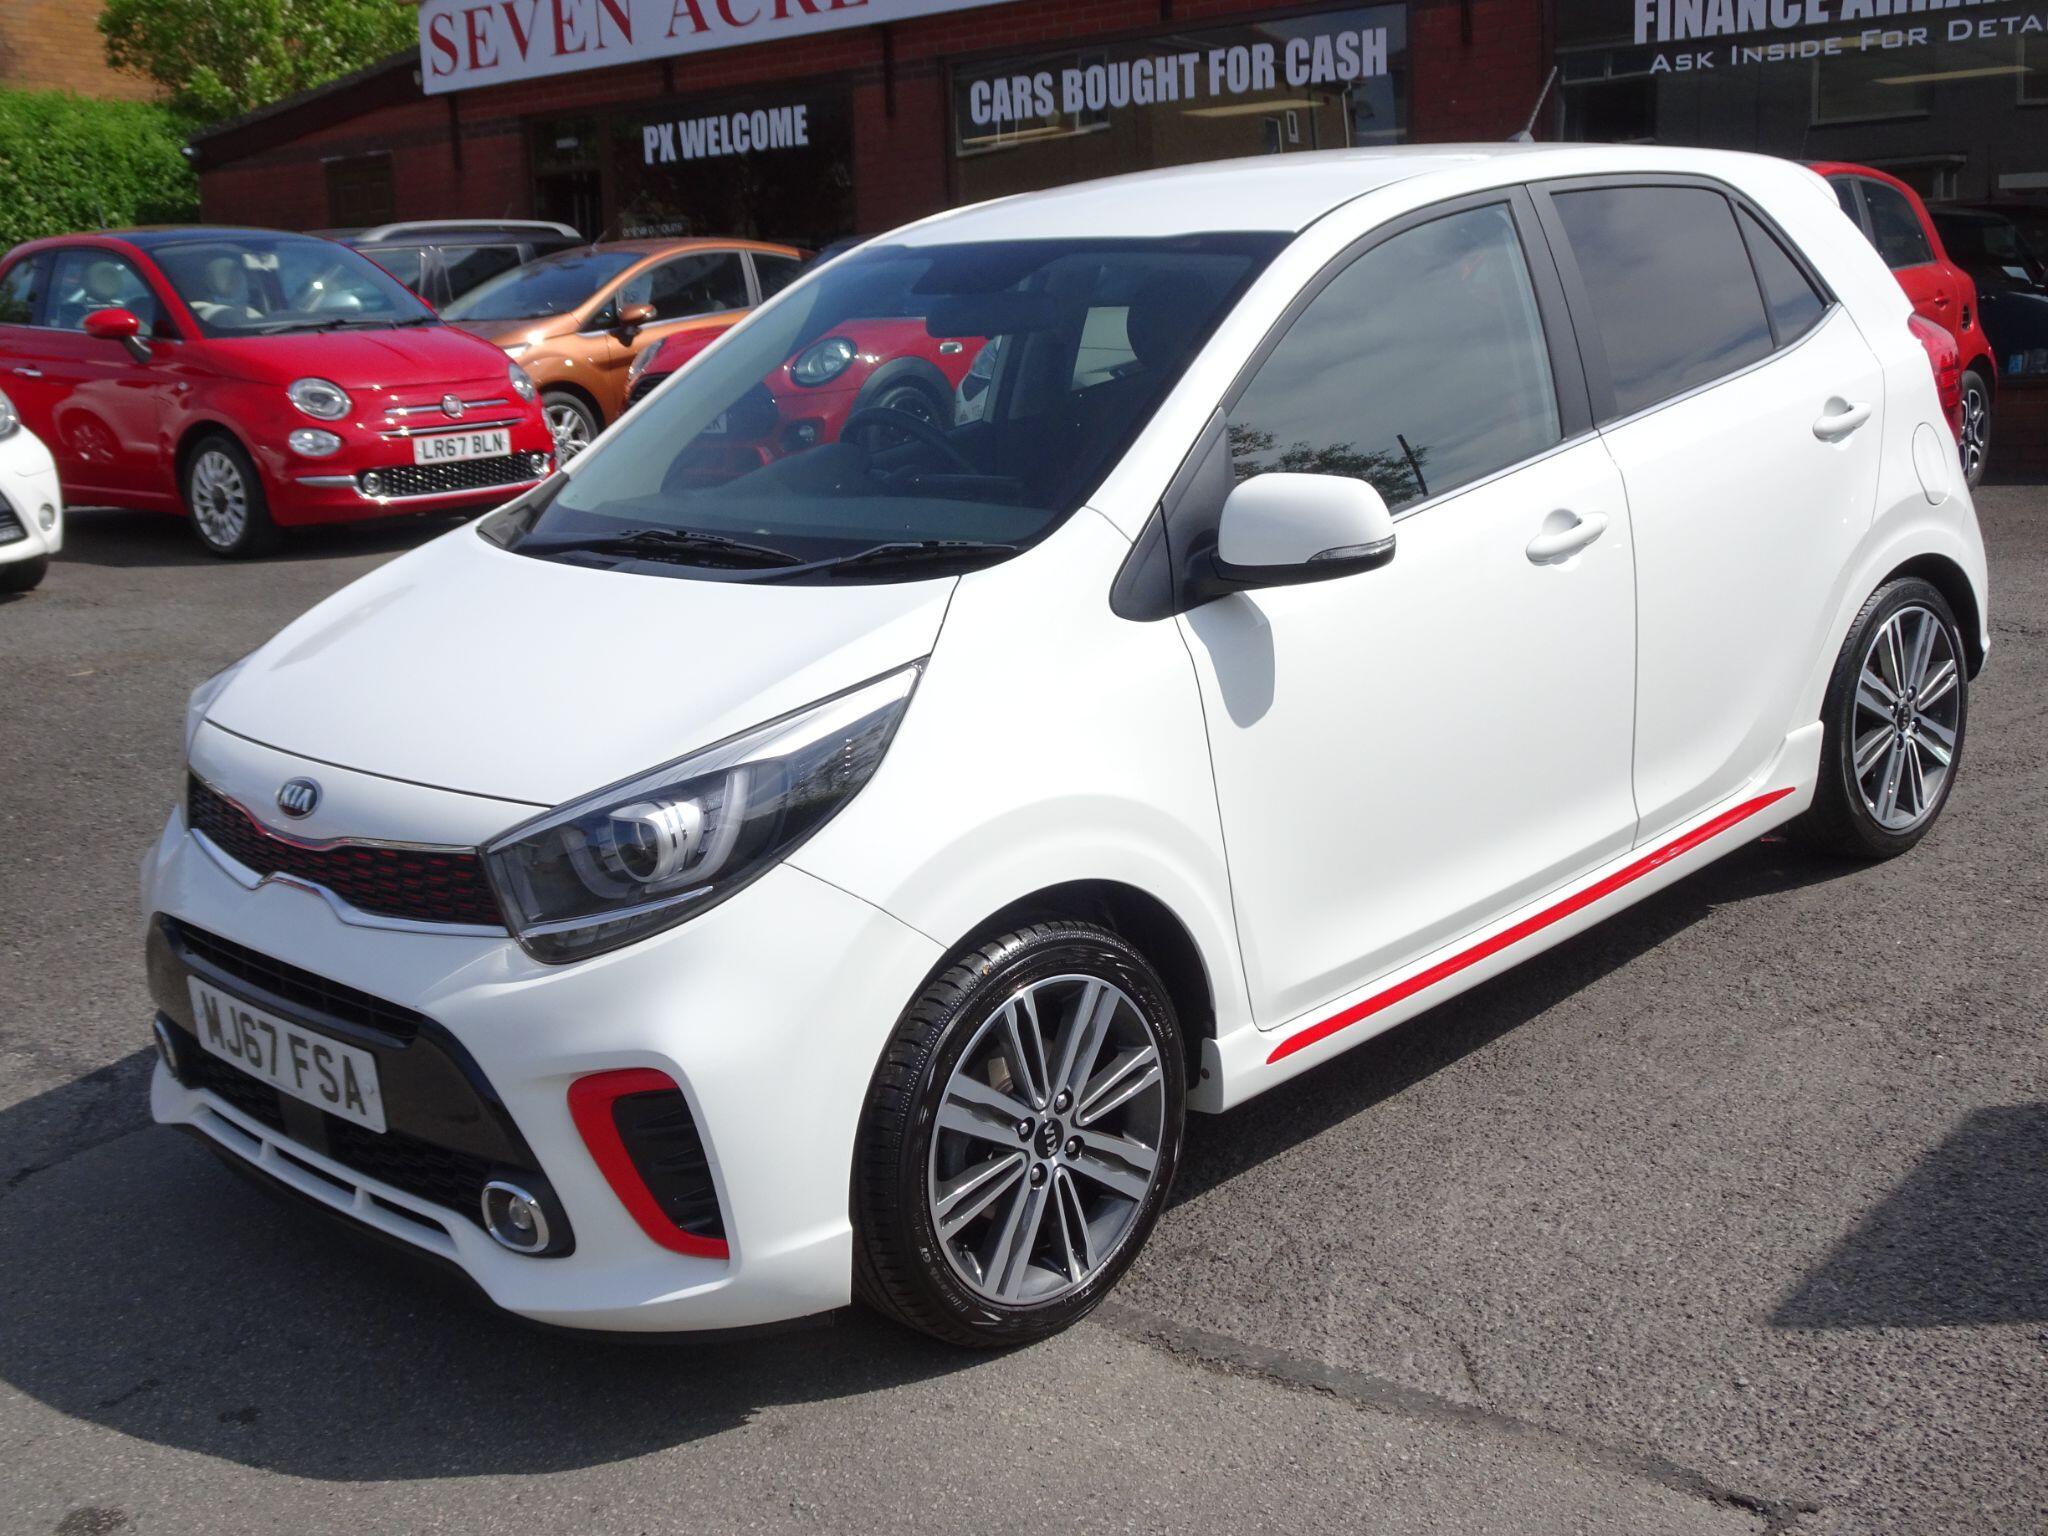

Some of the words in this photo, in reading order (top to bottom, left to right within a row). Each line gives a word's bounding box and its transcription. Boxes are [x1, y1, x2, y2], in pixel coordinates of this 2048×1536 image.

[429, 0, 633, 77] SEVEN
[1649, 51, 1714, 75] ASK
[1731, 36, 1842, 66] INSIDE
[1861, 27, 1928, 51] FOR
[970, 72, 1054, 125] CARS
[1062, 53, 1200, 113] BOUGHT
[1208, 43, 1275, 96] FOR
[1285, 27, 1388, 87] CASH
[643, 122, 677, 165] PX
[679, 104, 809, 160] WELCOME
[422, 437, 466, 459] LR67
[471, 433, 503, 454] BLN
[280, 783, 312, 812] KIA
[287, 1032, 367, 1116] FSA
[1044, 1121, 1057, 1157] KIA
